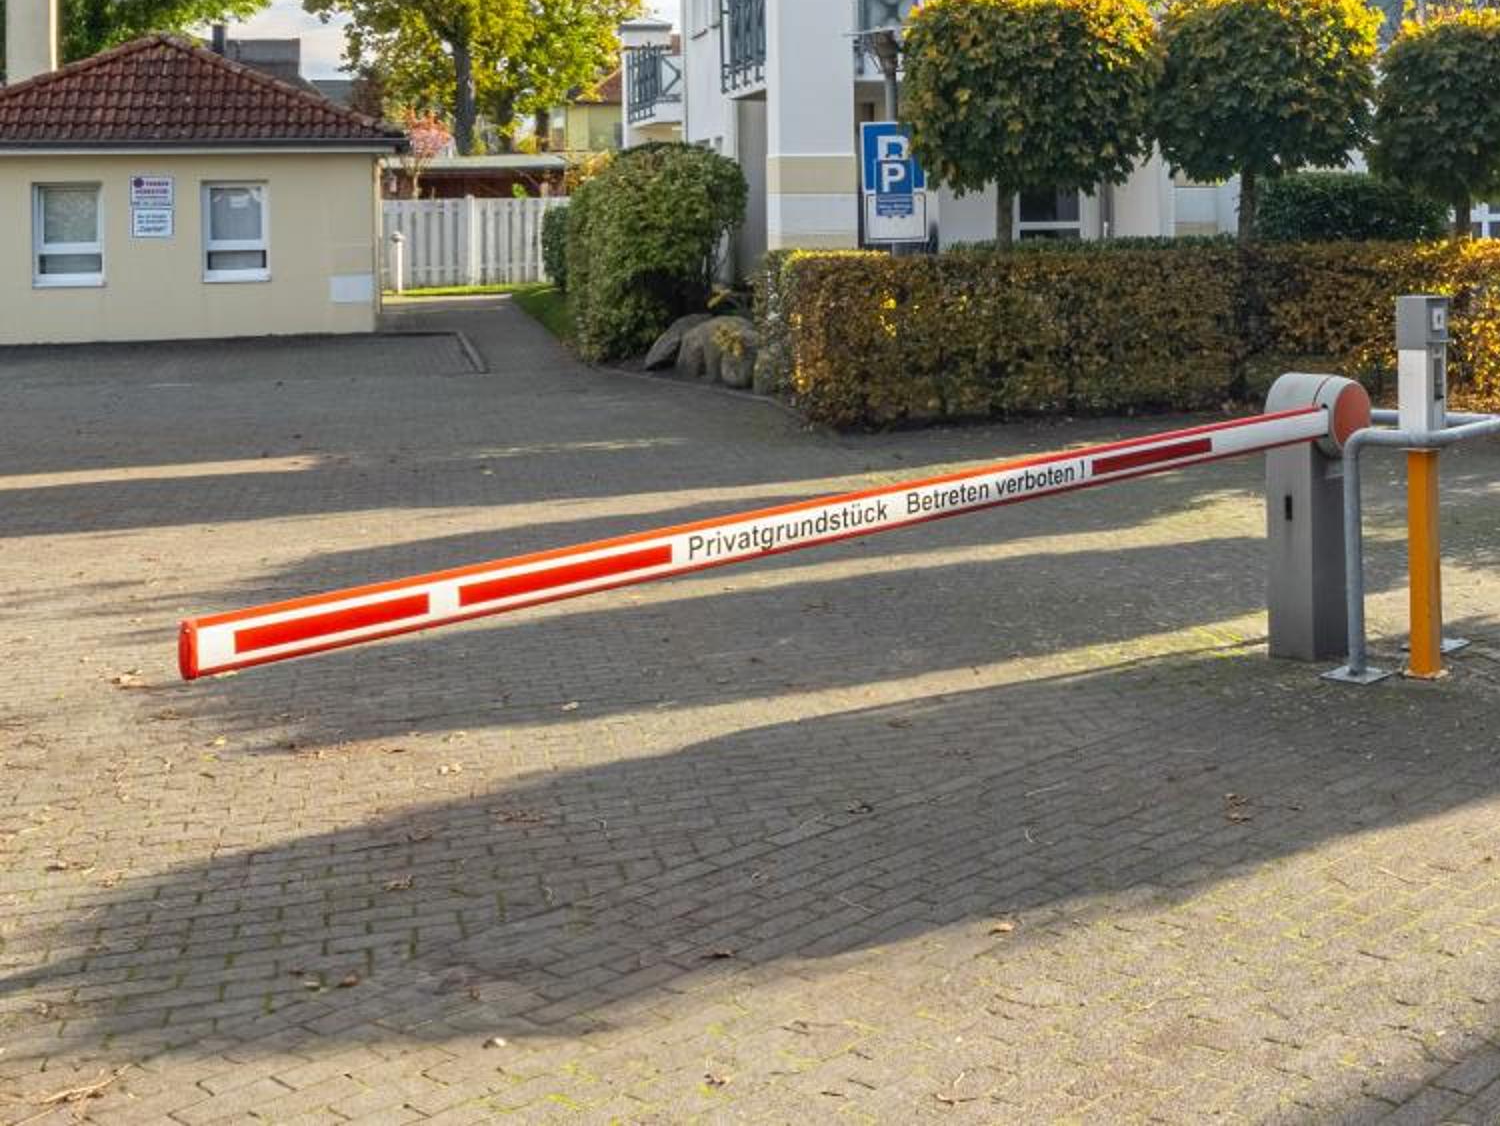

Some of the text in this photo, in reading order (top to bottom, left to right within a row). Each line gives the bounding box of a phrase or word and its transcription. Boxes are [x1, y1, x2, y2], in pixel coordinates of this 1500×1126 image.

[881, 163, 905, 193] P
[688, 500, 887, 560] Privatgrundstück
[906, 483, 989, 514] Betreten
[995, 463, 1075, 496] verboten
